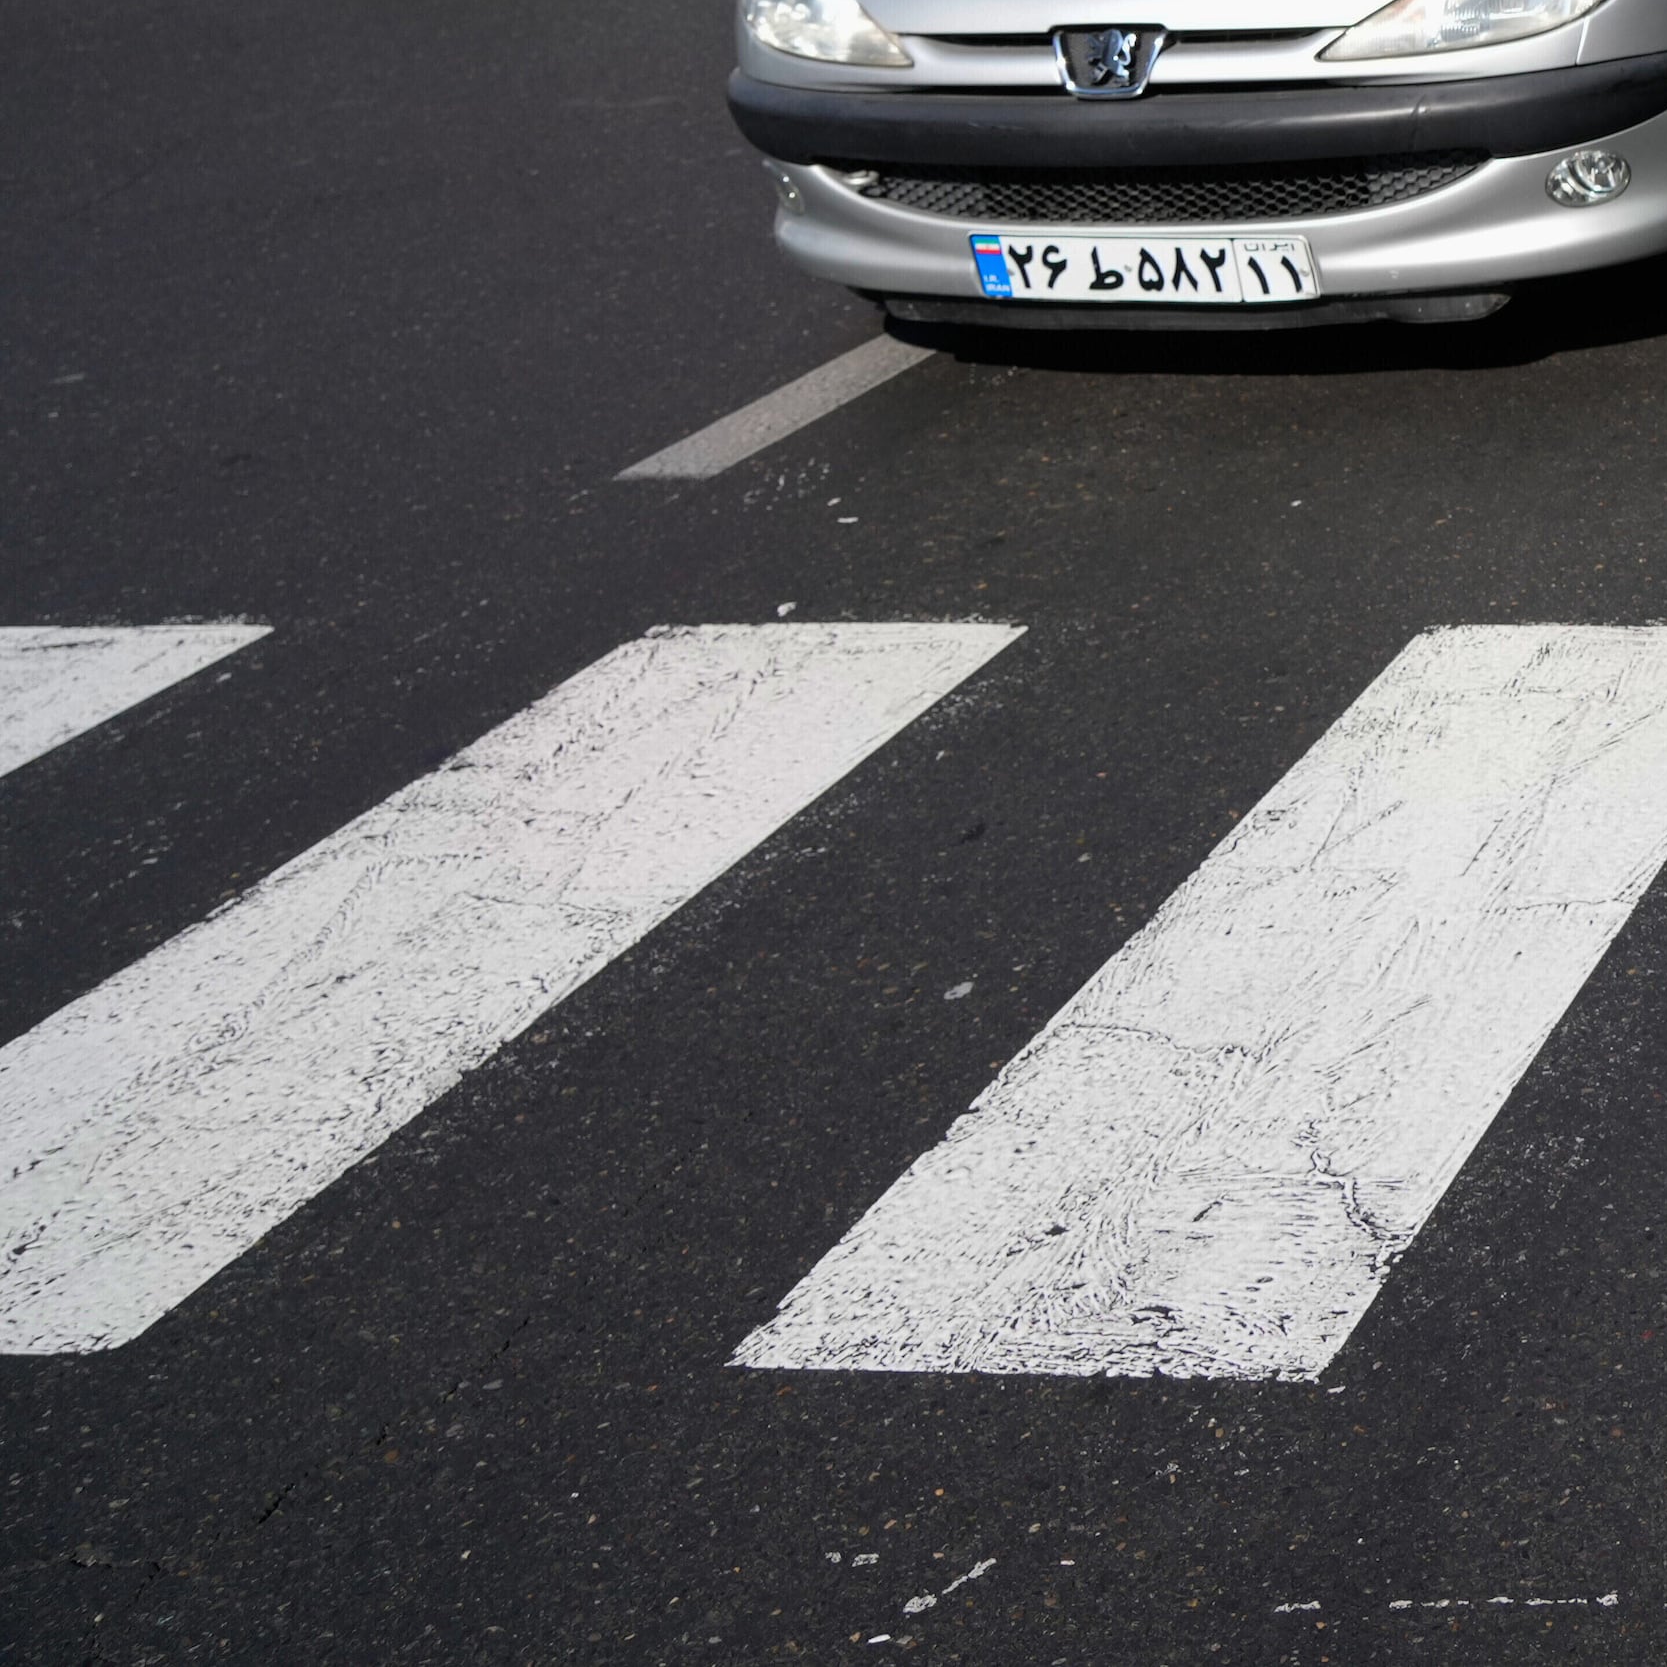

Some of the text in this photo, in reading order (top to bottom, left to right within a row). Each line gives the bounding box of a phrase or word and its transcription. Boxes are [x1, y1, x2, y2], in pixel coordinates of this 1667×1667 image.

[1007, 244, 1303, 294] ۲۶ ط ۵۸۲ ۱۱
